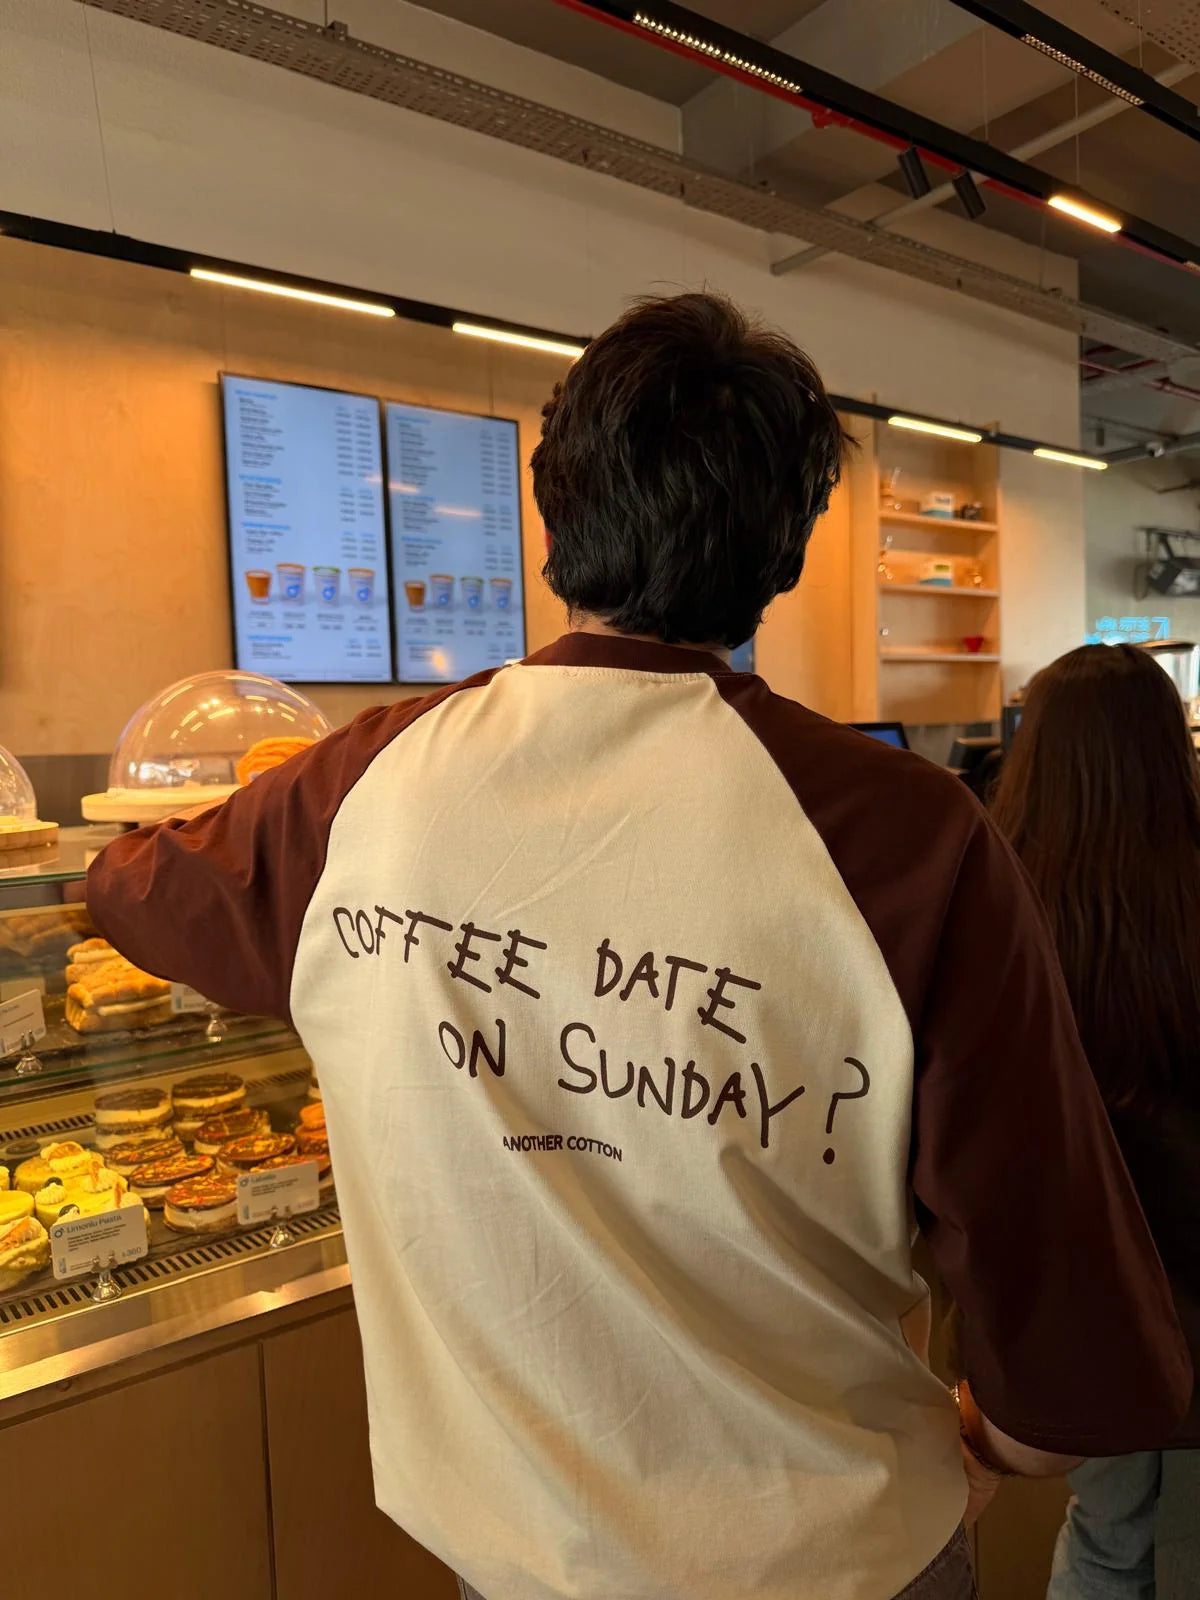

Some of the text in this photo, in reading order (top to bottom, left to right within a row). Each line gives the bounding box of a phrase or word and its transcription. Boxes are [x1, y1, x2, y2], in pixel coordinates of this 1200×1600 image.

[332, 904, 762, 1045] COFFEE DATE
[438, 1018, 506, 1079] ON
[502, 1134, 623, 1163] ANOTHER COTTON
